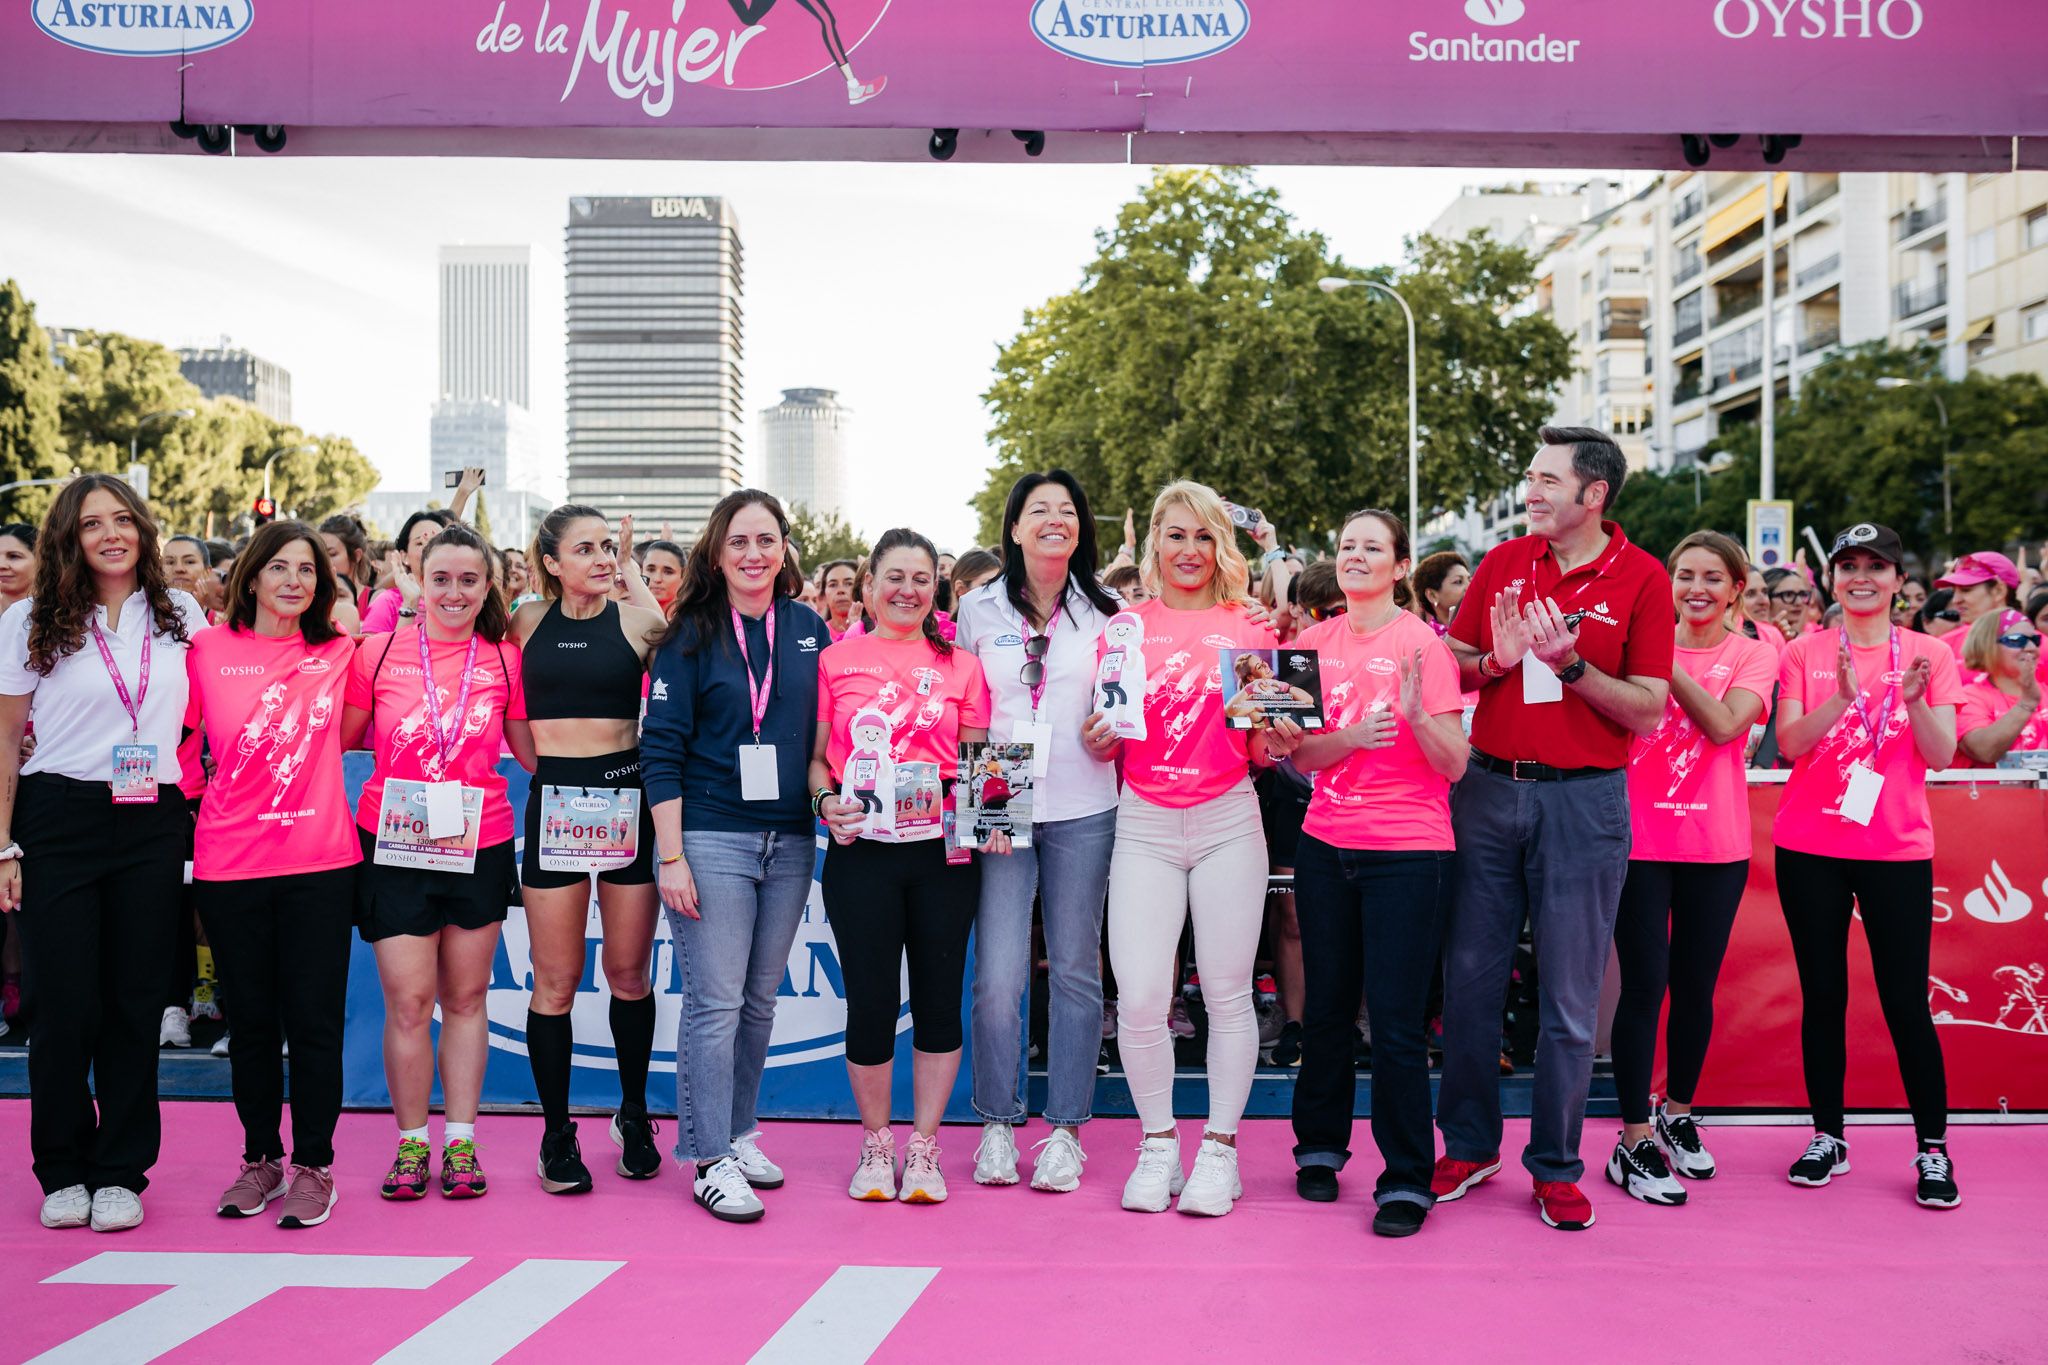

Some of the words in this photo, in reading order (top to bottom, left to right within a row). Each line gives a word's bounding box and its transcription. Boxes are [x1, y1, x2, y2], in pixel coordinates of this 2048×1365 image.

[49, 0, 235, 29] ASTURIANA
[1048, 0, 1231, 38] ASTURIANA
[1714, 0, 1923, 39] OYSHO
[475, 0, 523, 53] de
[534, 0, 569, 53] la
[1409, 31, 1580, 63] Santander
[560, 0, 767, 117] Mujer
[651, 197, 707, 218] BBVA
[1143, 636, 1173, 645] YSHO
[220, 665, 265, 676] OYSHO
[117, 750, 150, 758] MUJER
[574, 799, 608, 808] ASTURIANA
[895, 796, 913, 812] 16
[572, 825, 608, 839] 016
[388, 842, 410, 851] CARRERA
[445, 848, 465, 856] MADRID
[416, 838, 438, 846] 13086
[385, 852, 417, 863] OYSHO
[435, 858, 465, 867] Santander
[549, 859, 580, 867] OYSHO
